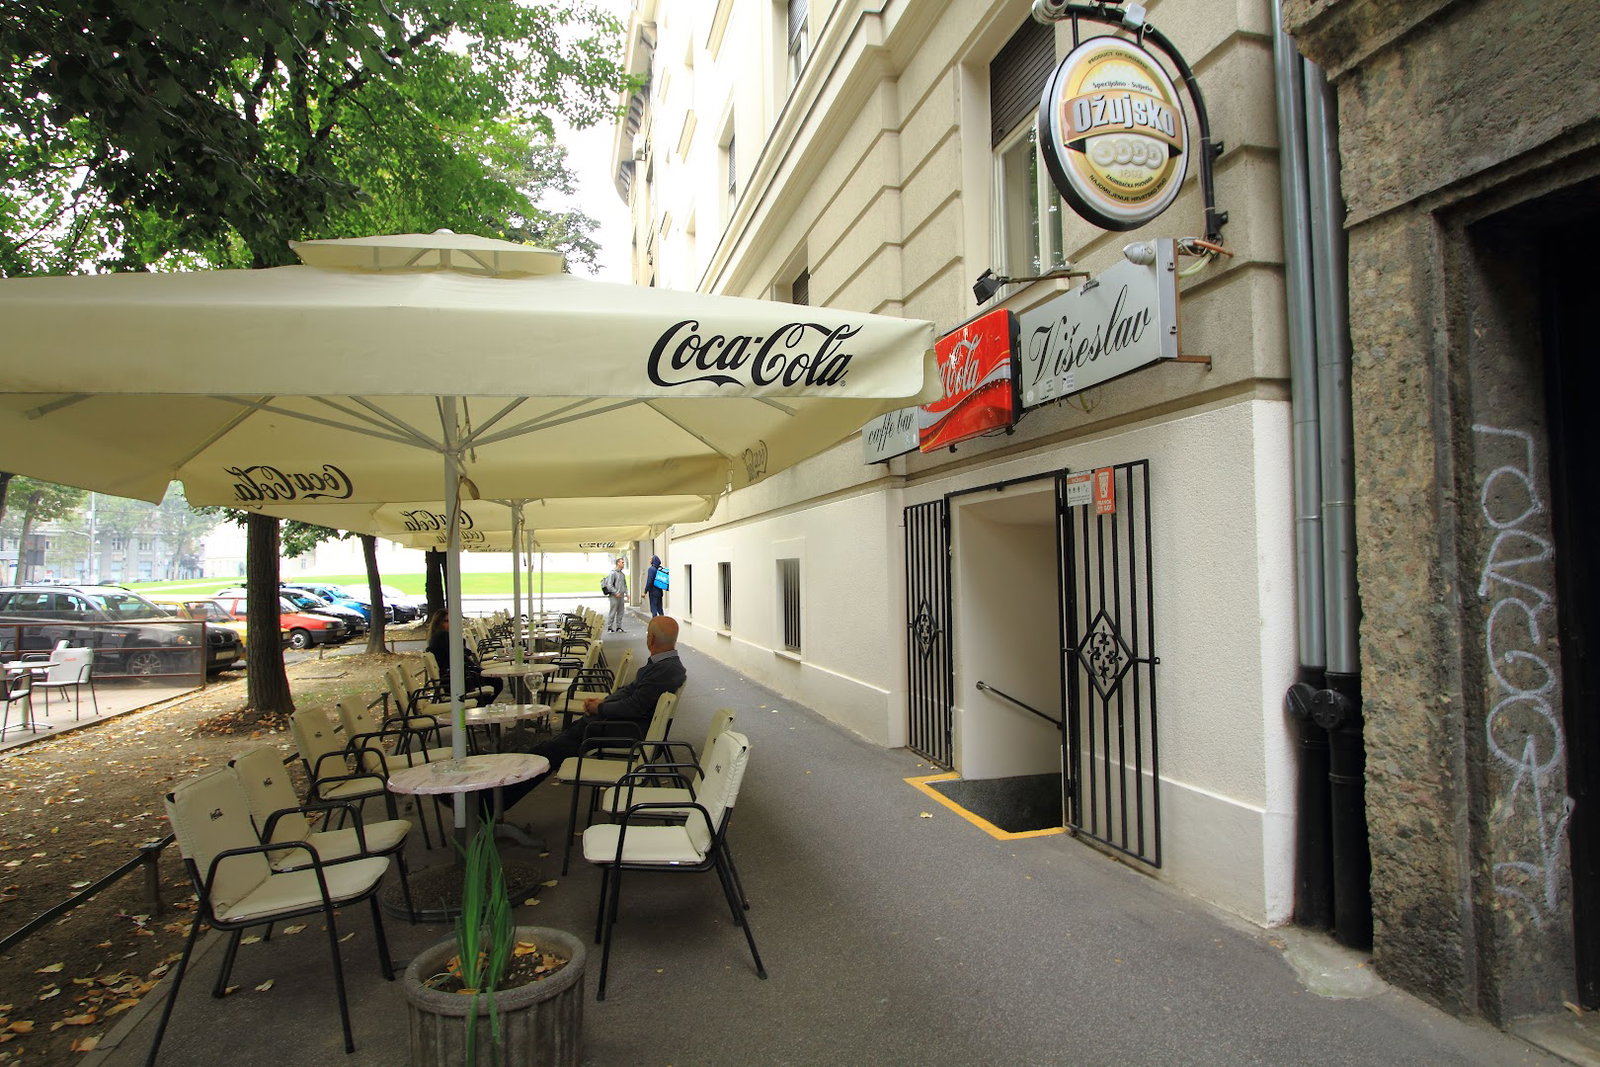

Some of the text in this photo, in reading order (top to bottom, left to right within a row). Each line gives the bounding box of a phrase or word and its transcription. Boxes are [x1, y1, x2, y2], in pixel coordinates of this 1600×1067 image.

[1072, 93, 1176, 138] Ožujsko
[647, 319, 864, 388] Coca-Cola
[1028, 284, 1152, 387] Višeslav
